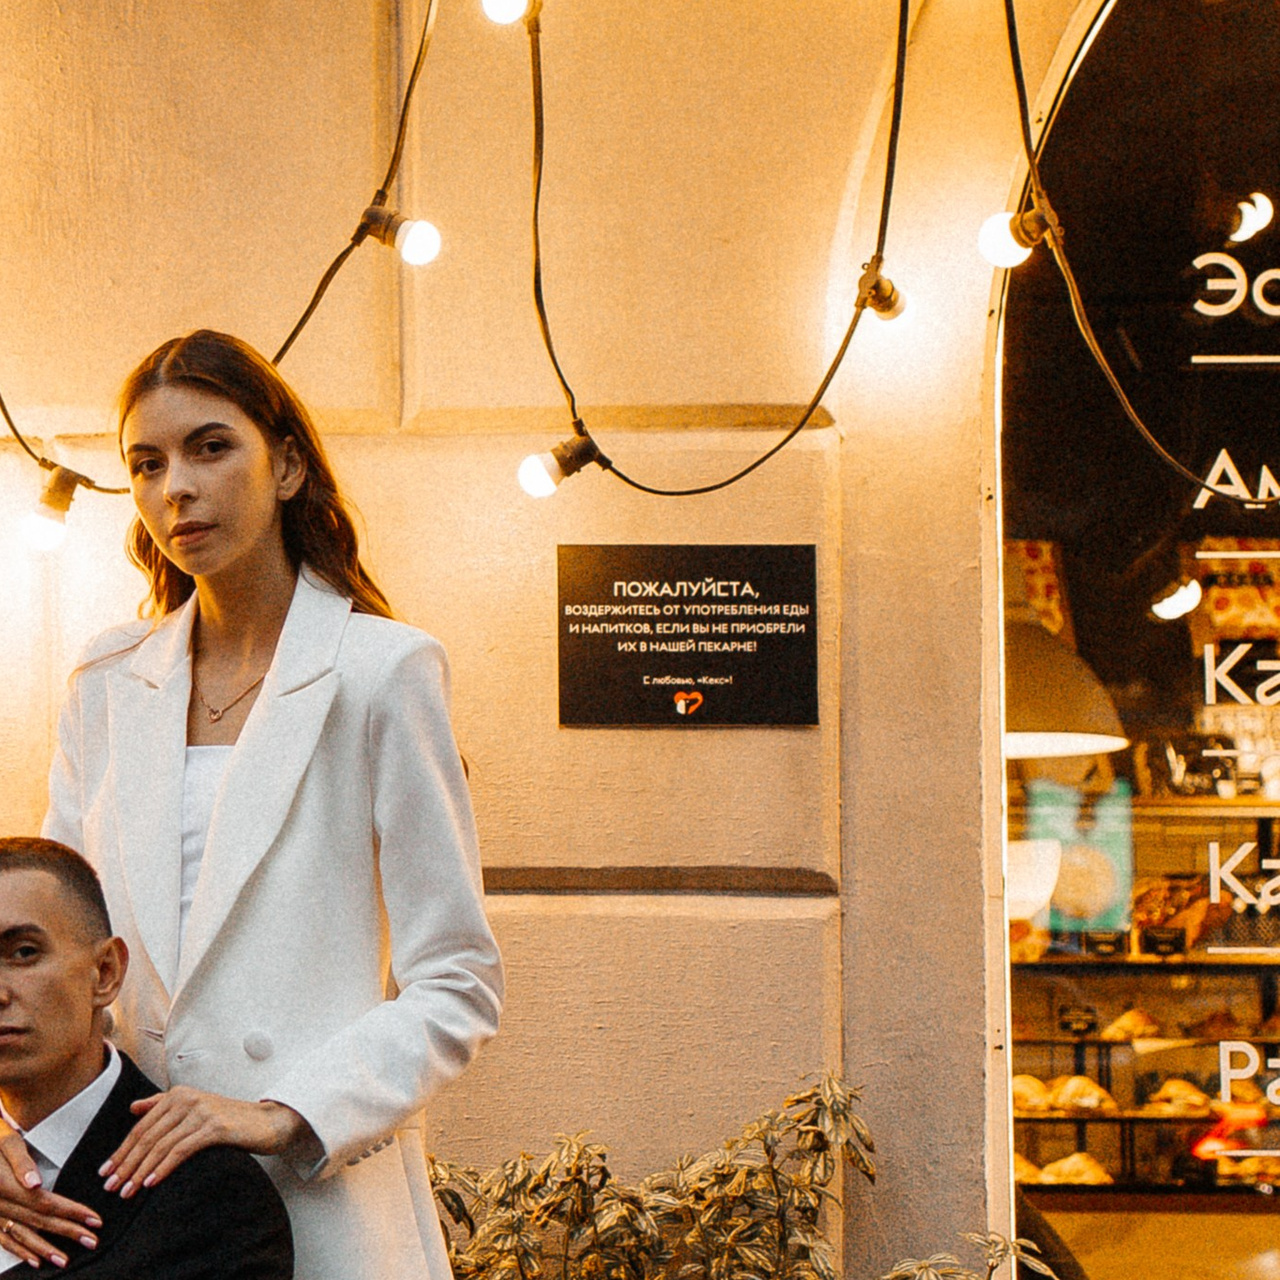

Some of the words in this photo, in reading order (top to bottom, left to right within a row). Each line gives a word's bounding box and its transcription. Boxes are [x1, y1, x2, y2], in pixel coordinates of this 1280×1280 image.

[613, 577, 760, 599] ПОЖАЛУЙСТА,
[565, 604, 661, 617] ВОЗДЕРЖИТЕСЬ
[663, 605, 681, 615] ОТ
[683, 604, 781, 616] УПОТРЕБЛЕНИЯ
[783, 604, 809, 617] ЕДЫ
[569, 623, 579, 634] И
[581, 623, 654, 635] НАПИТКОВ,
[656, 623, 690, 634] ЕСЛИ
[692, 623, 710, 634] ВЫ
[712, 623, 728, 634] НЕ
[731, 623, 806, 634] ПРИОБРЕЛИ
[617, 641, 637, 652] ИХ
[640, 641, 647, 652] В
[649, 639, 696, 652] НАШЕЙ
[698, 641, 757, 652] ПЕКАРНЕ!
